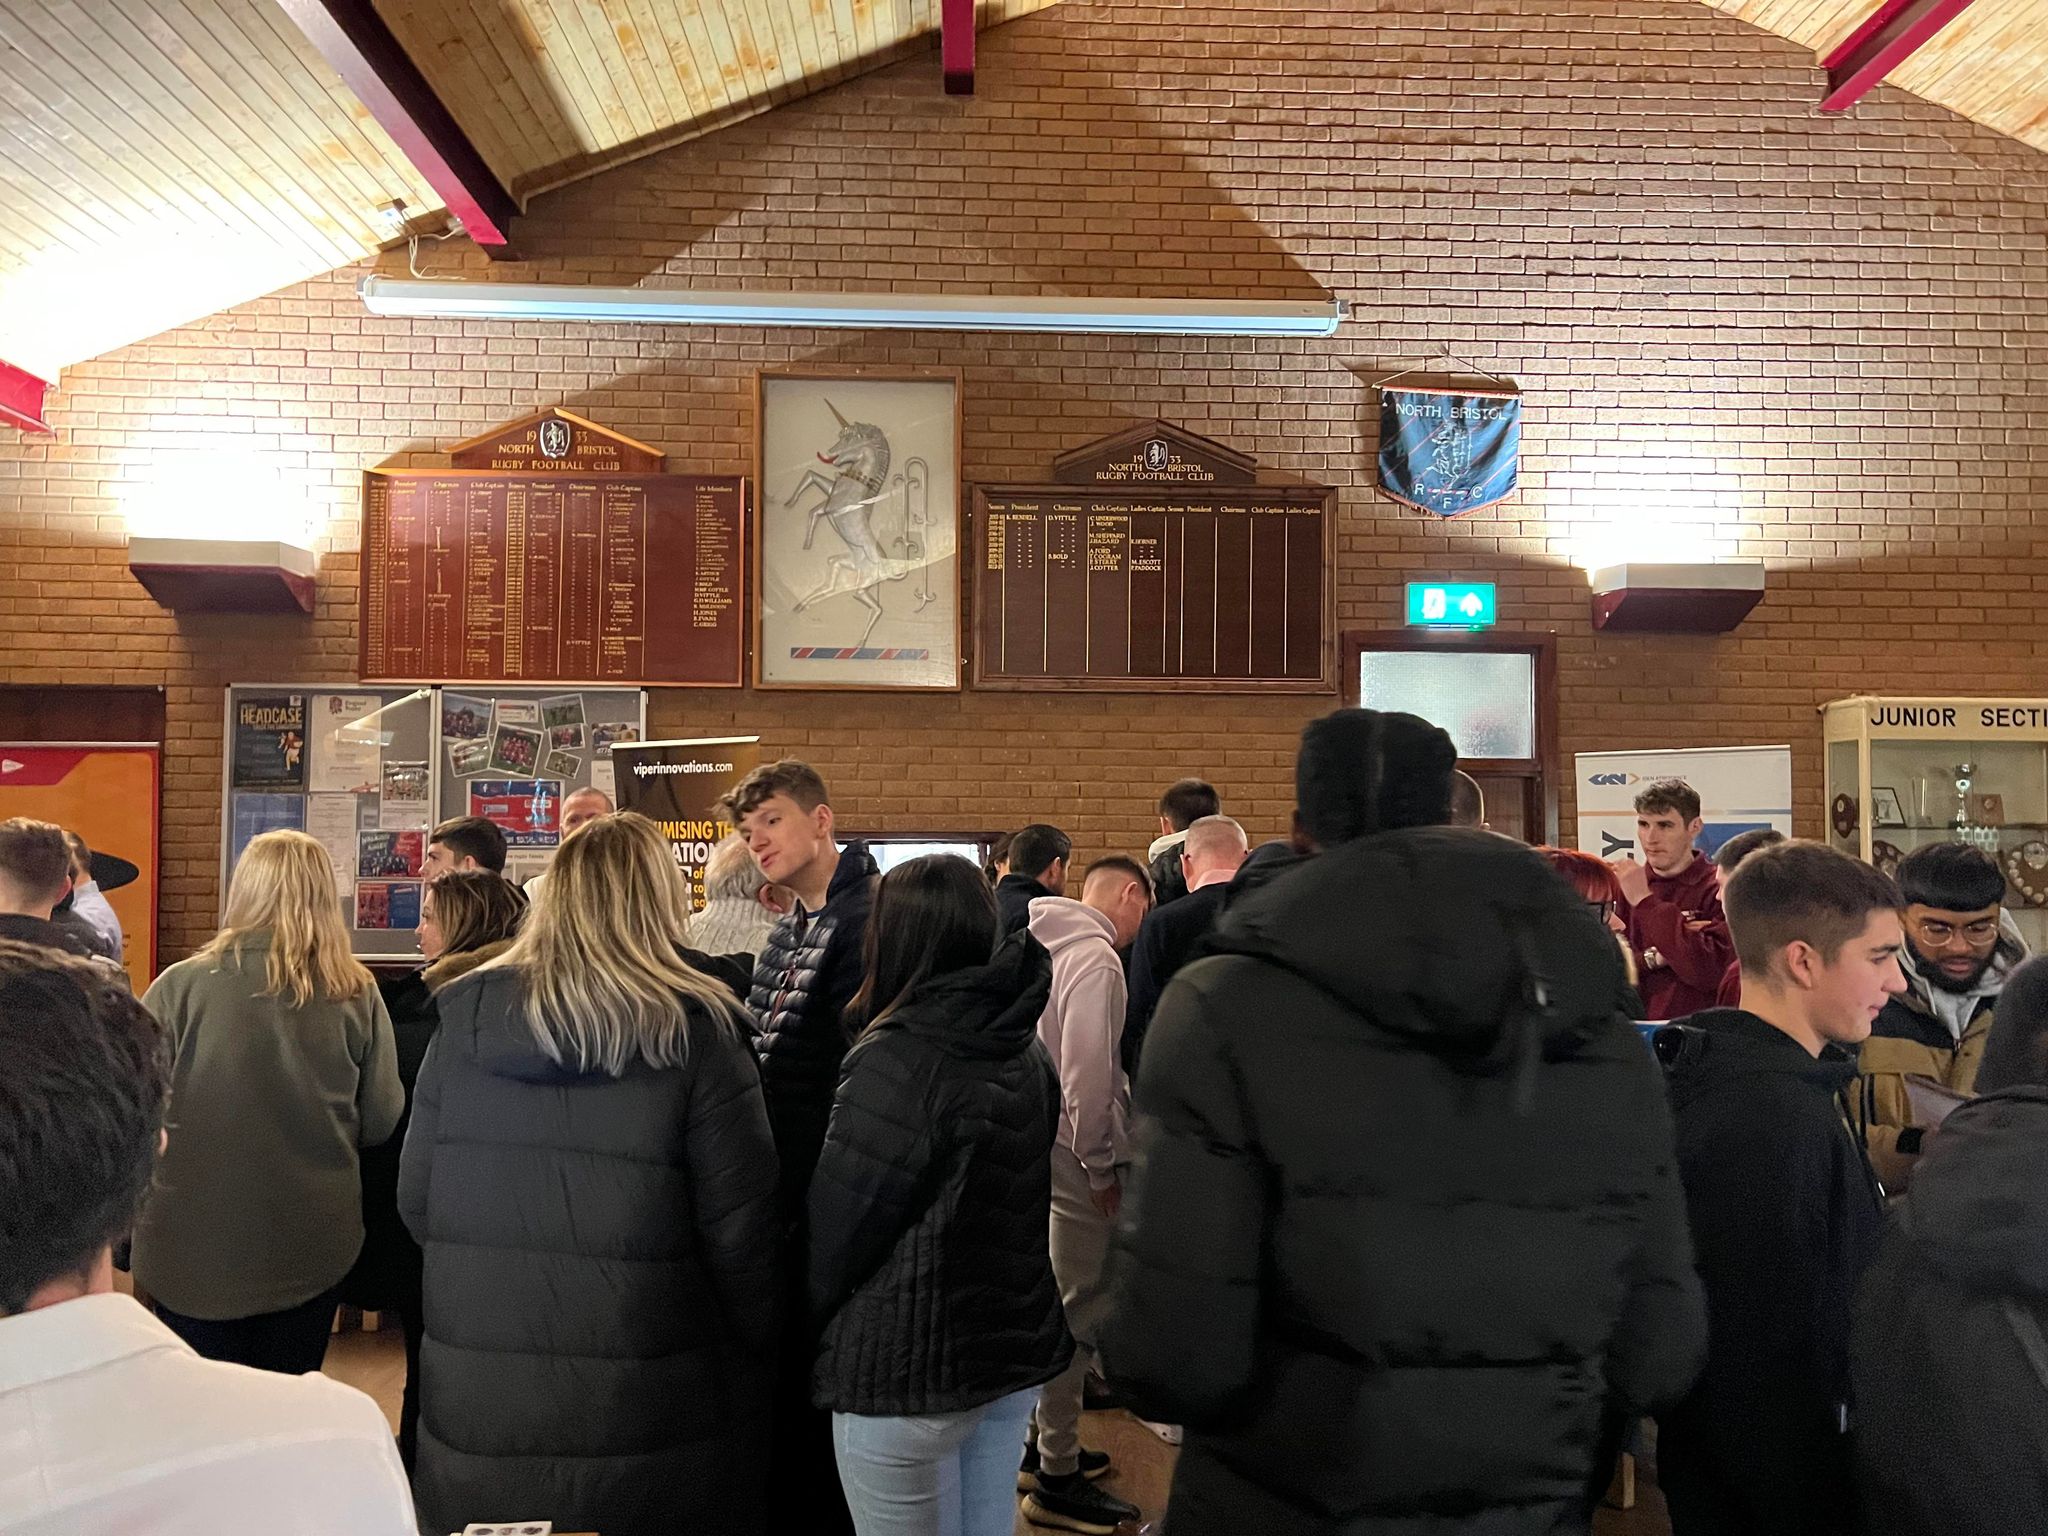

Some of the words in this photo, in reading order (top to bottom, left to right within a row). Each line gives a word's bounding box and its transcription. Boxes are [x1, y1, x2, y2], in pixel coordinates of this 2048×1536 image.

[1396, 404, 1442, 418] NORTH
[1450, 407, 1507, 420] BRISTOL
[526, 430, 536, 442] 19
[498, 444, 534, 454] NORTH
[577, 446, 617, 455] BRISTOL
[492, 460, 524, 469] RUGBY
[532, 460, 584, 470] FOOTBALL
[593, 461, 620, 470] CLUB
[1133, 455, 1144, 463] 19
[1170, 456, 1181, 464] 33
[1108, 463, 1142, 472] NORTH
[1168, 464, 1204, 472] BRISTOL
[1096, 472, 1128, 480] RUGBY
[1132, 472, 1184, 480] FOOTBALL
[1188, 472, 1214, 480] CLUB
[1414, 484, 1424, 495] R
[1472, 486, 1482, 498] C
[1443, 497, 1452, 508] F
[240, 706, 302, 724] HEADCASE
[1870, 707, 1956, 728] JUNIOR
[1980, 708, 2048, 728] SECTI
[633, 760, 733, 778] viperinnovations.com
[1588, 773, 1626, 785] GKN
